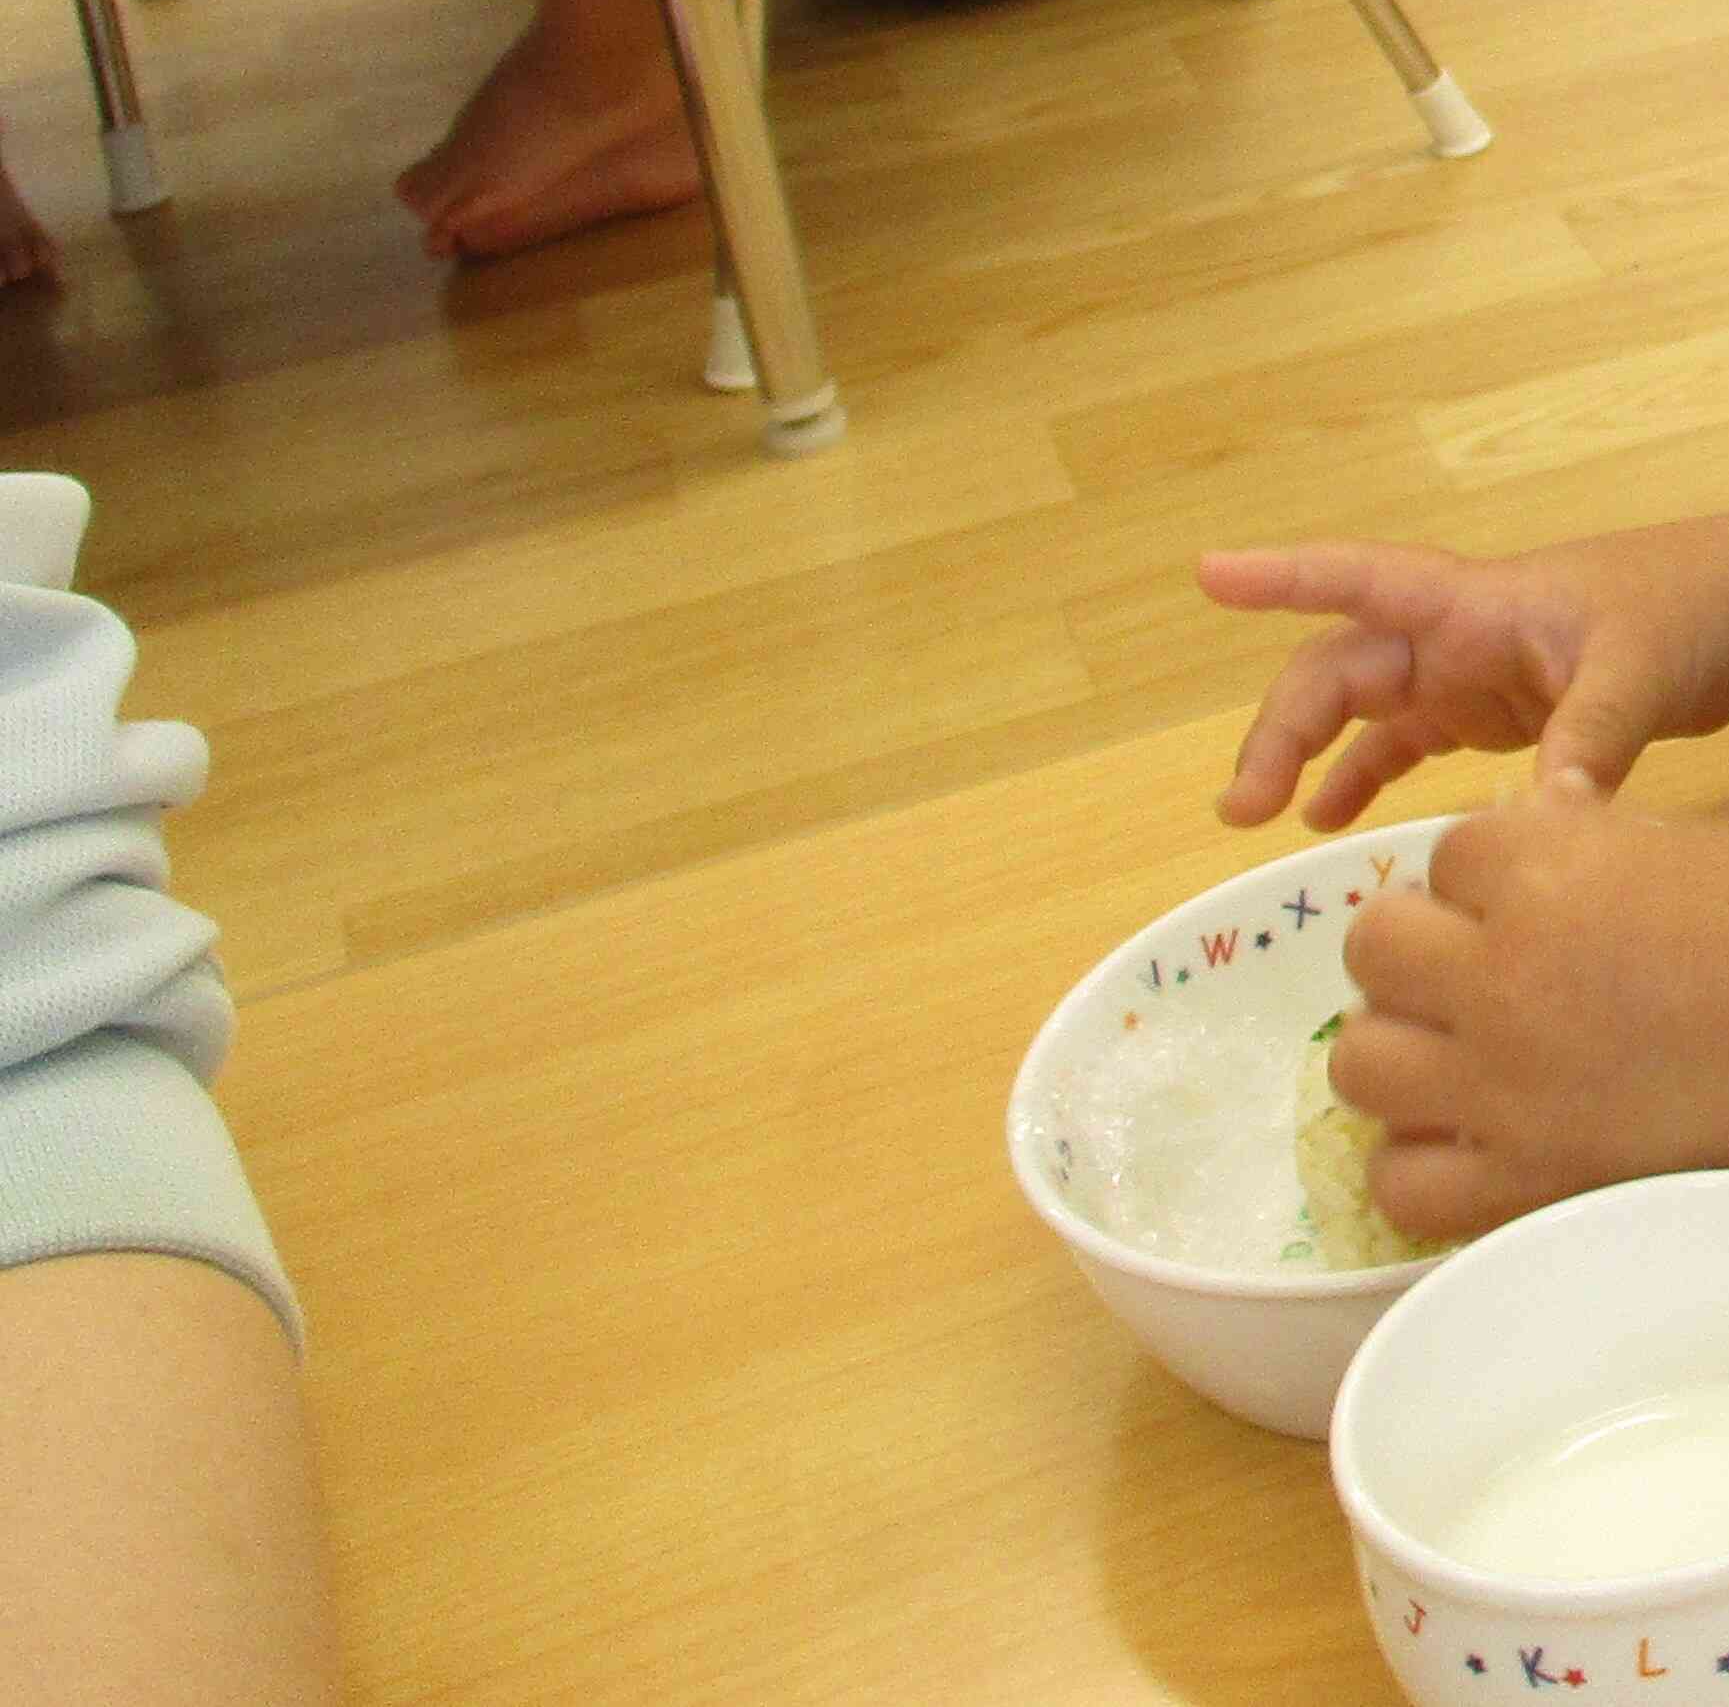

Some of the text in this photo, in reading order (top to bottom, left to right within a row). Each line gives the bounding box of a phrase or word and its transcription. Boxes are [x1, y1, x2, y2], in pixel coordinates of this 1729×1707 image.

[1200, 926, 1240, 969] W
[1281, 889, 1322, 931] X
[1370, 854, 1395, 889] Y
[1403, 1598, 1427, 1636] J
[1518, 1646, 1559, 1688] K
[1638, 1636, 1668, 1677] L
